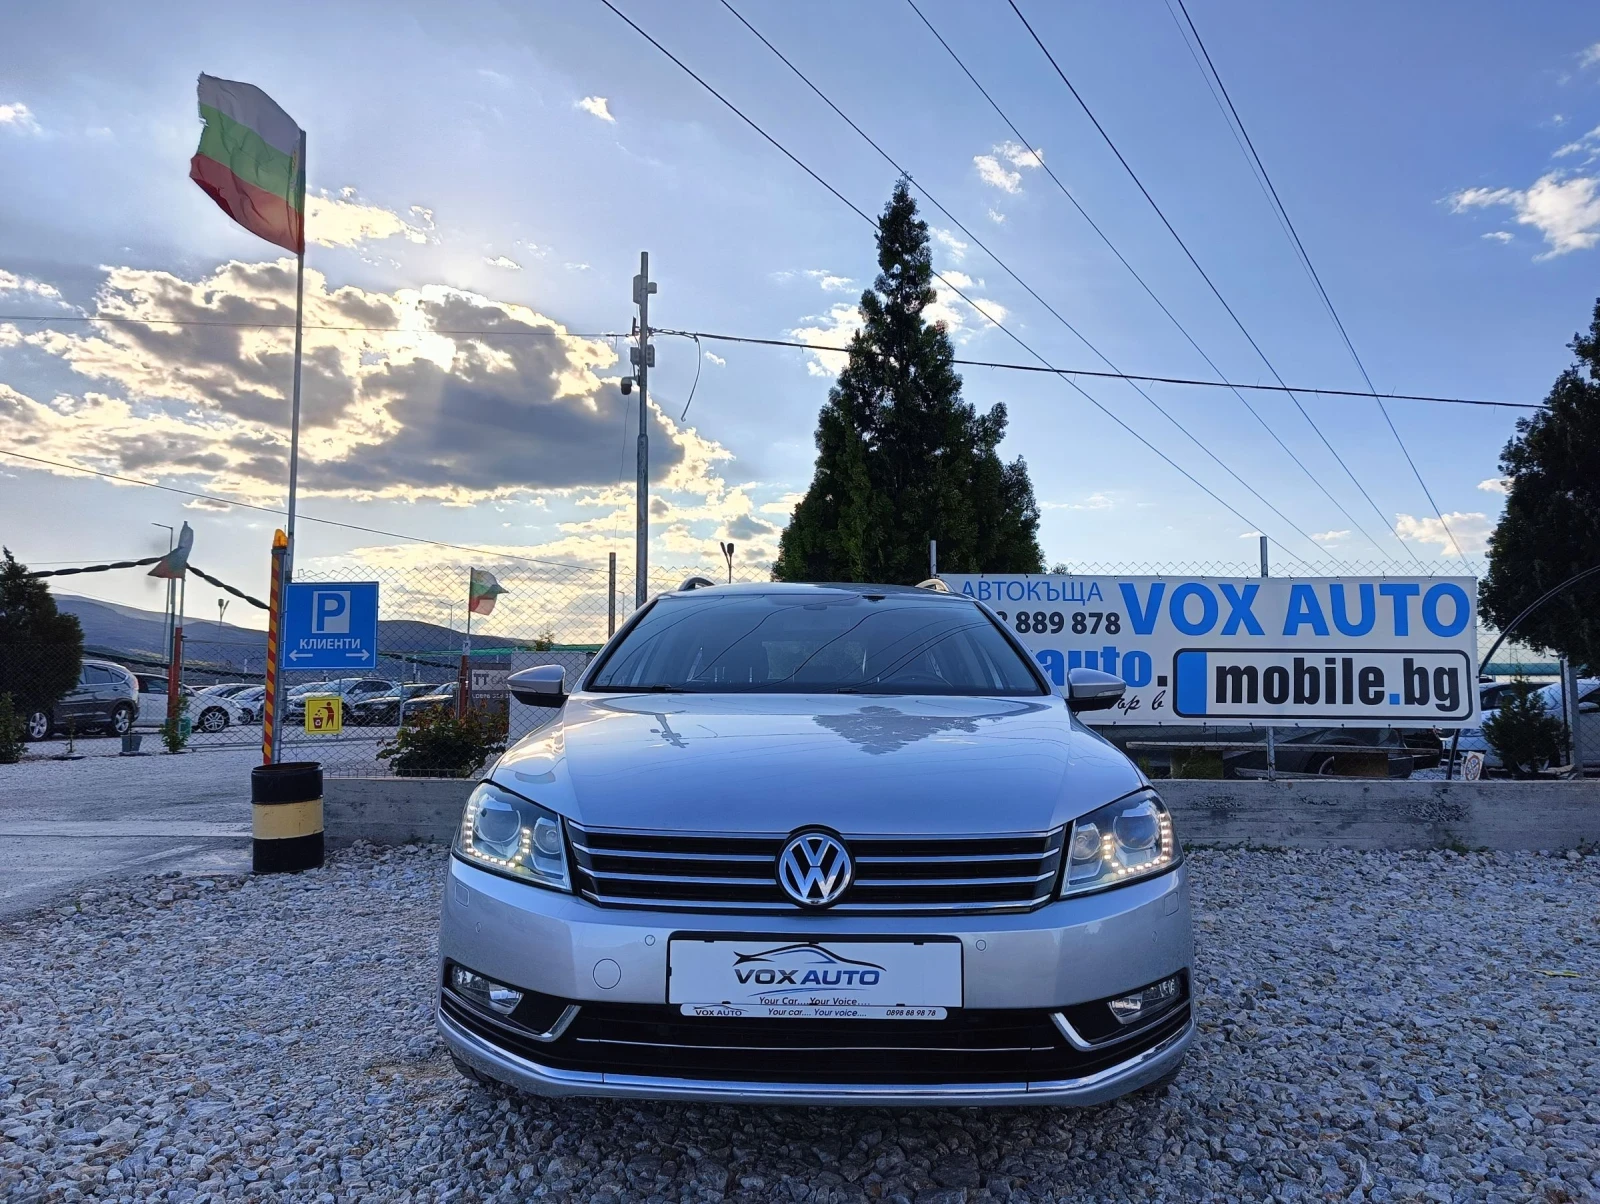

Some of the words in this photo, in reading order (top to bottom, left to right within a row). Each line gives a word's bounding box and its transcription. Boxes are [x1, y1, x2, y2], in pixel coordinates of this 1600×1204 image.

[962, 580, 1104, 606] АВТОКЪЩА
[316, 592, 346, 632] P
[1118, 582, 1266, 637] VOX
[1282, 582, 1471, 638] AUTO
[1015, 611, 1065, 634] 889
[1071, 612, 1121, 635] 878
[299, 638, 361, 650] КЛИЕНТИ
[473, 673, 489, 685] TT
[1215, 657, 1460, 713] mobile.bg
[759, 996, 780, 1005] Your
[768, 1007, 788, 1016] Your
[814, 1008, 833, 1017] Your
[927, 1009, 936, 1017] 78
